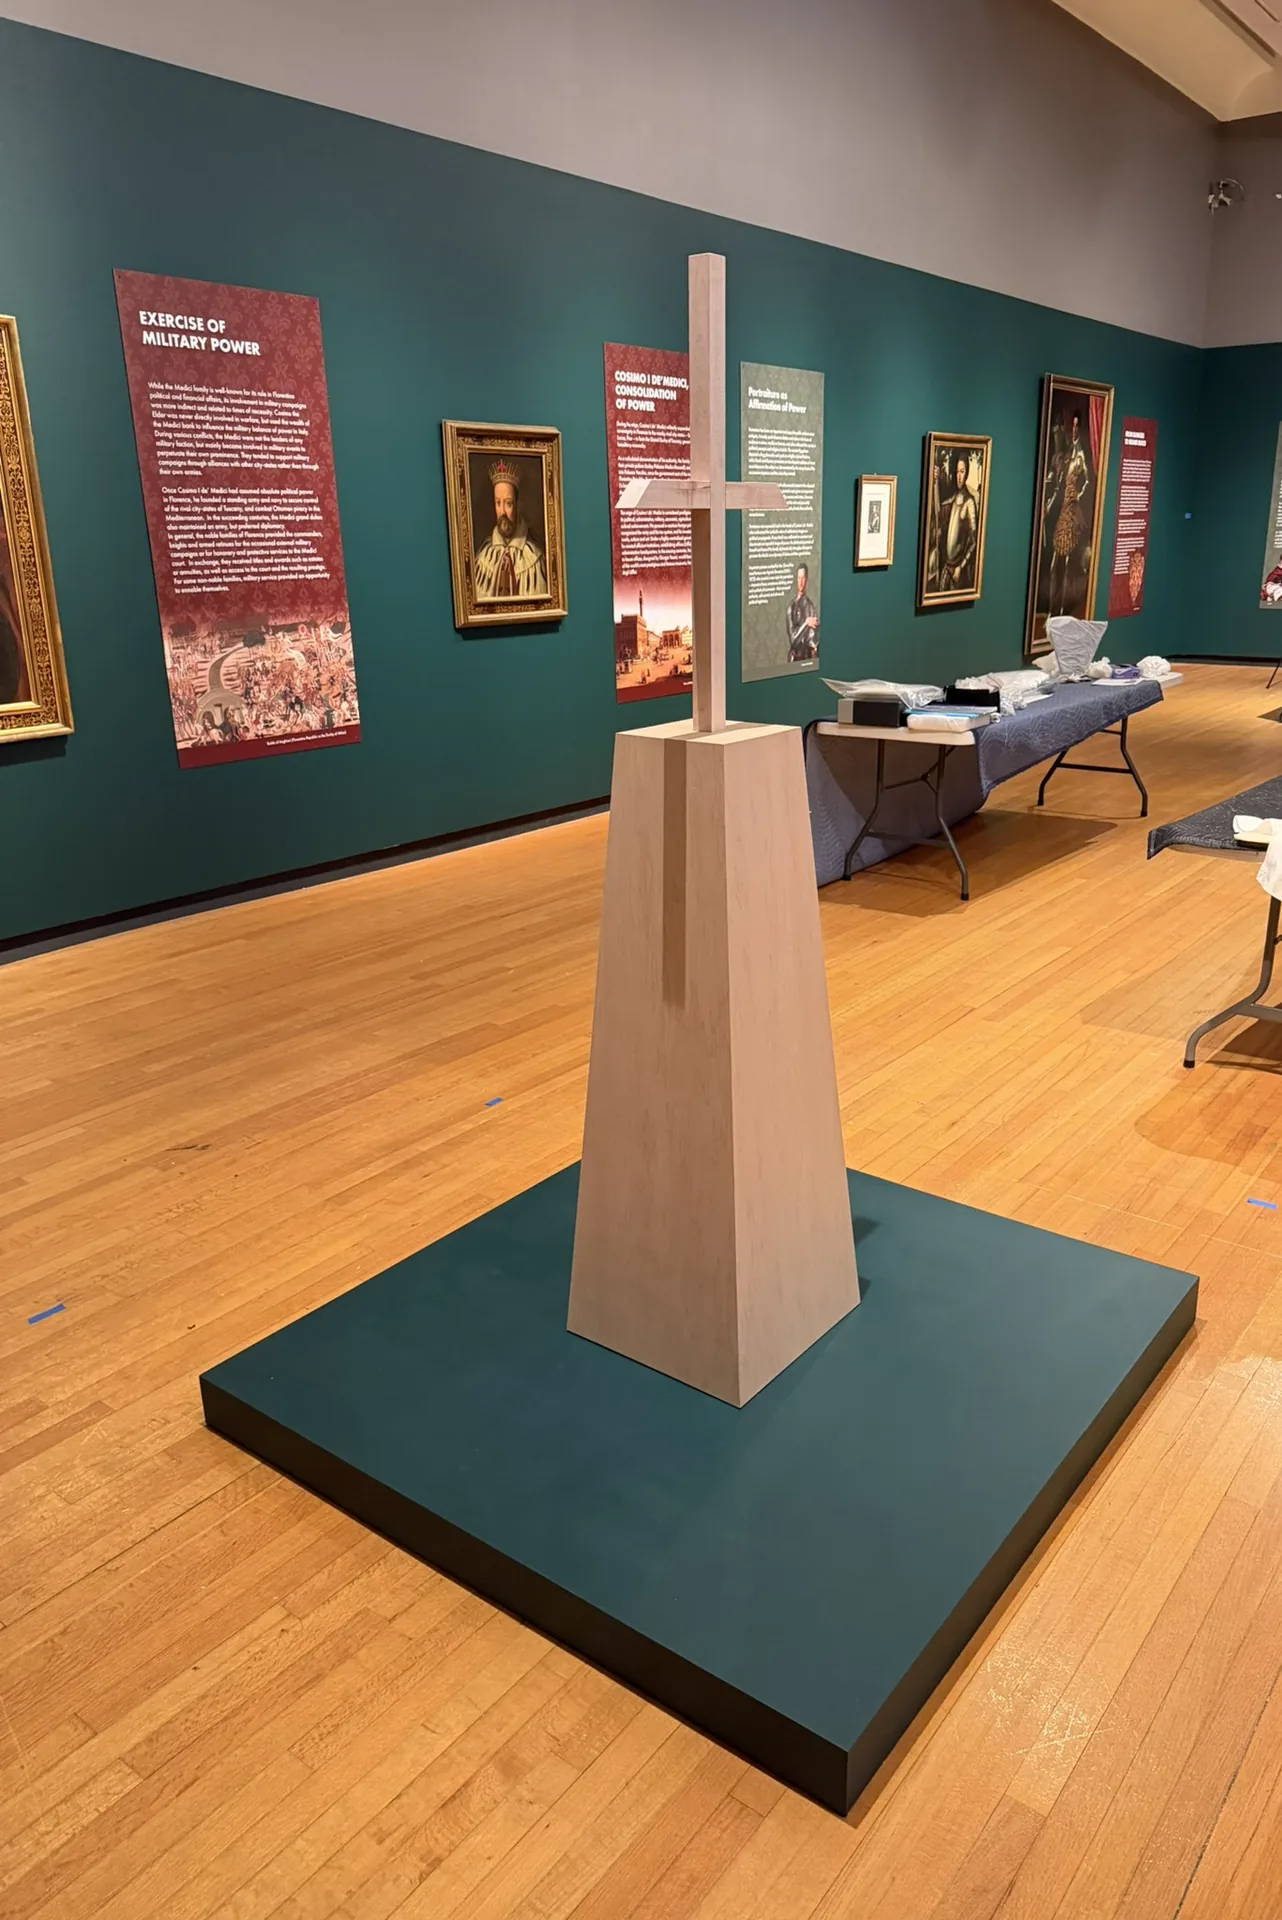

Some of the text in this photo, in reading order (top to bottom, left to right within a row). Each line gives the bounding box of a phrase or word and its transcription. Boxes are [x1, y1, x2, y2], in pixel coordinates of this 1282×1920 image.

[139, 310, 227, 334] EXERCISE OF
[141, 330, 261, 356] MILITARY POWER
[615, 371, 646, 384] COSIMO
[615, 385, 676, 400] CONSOLIDATION
[616, 399, 655, 412] OF POWER
[782, 402, 788, 412] of
[789, 403, 806, 414] Power
